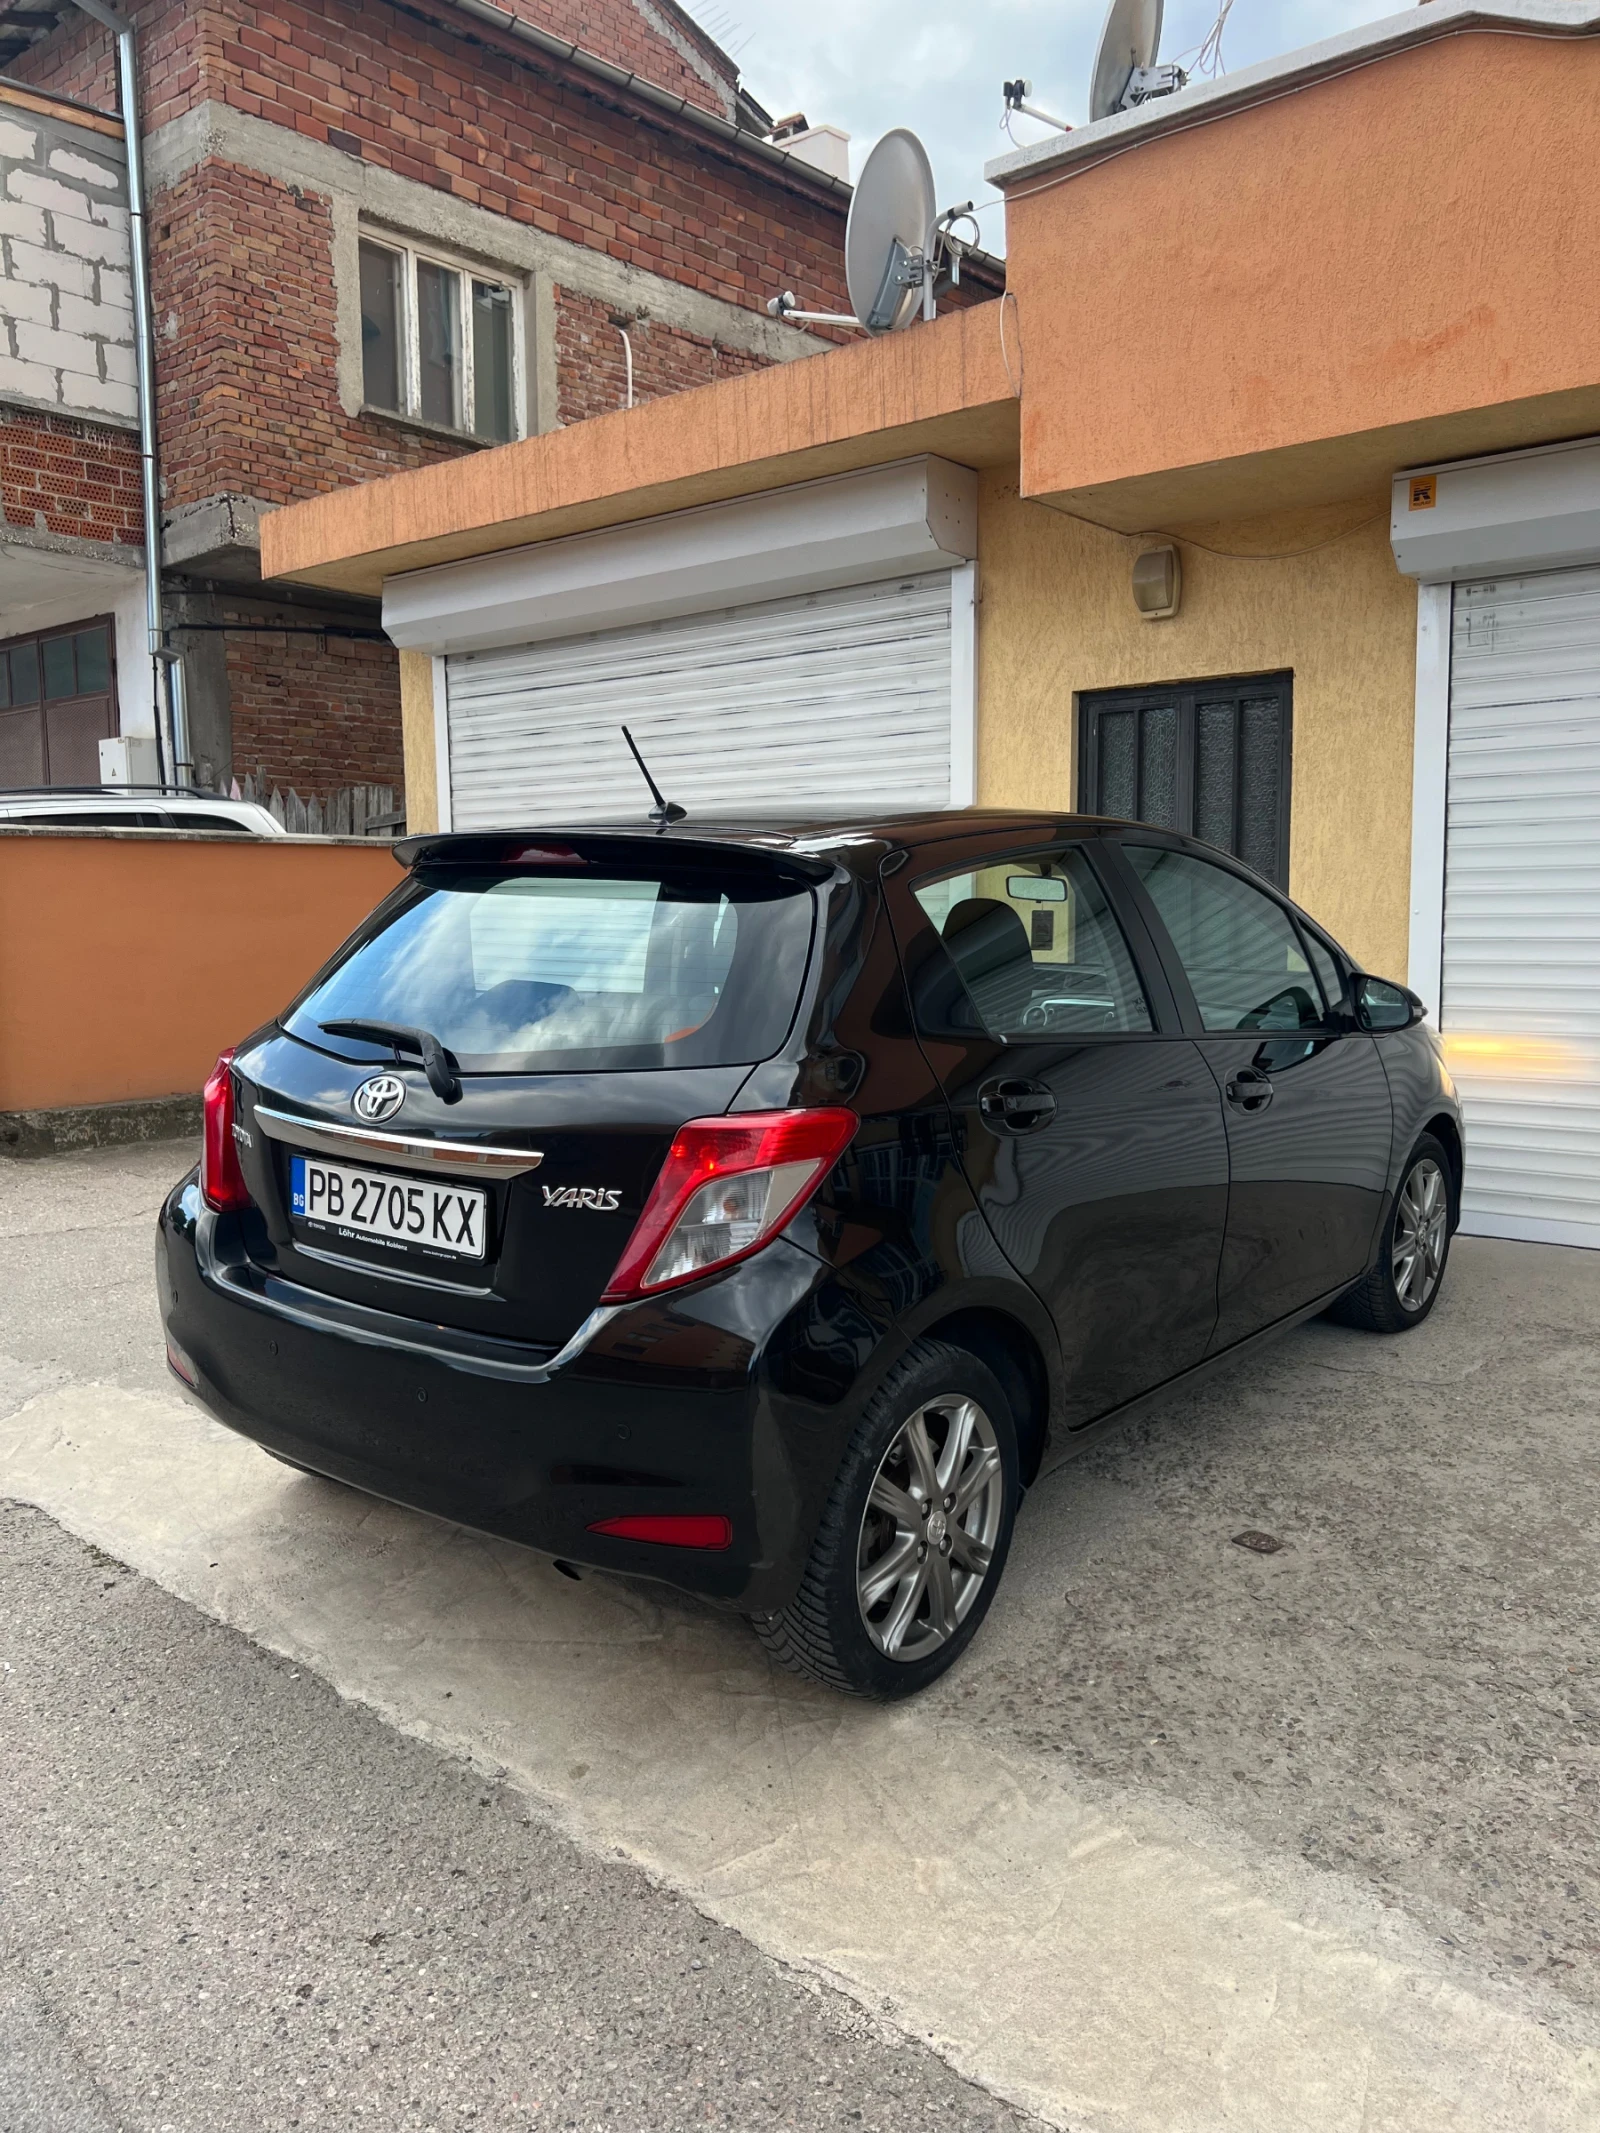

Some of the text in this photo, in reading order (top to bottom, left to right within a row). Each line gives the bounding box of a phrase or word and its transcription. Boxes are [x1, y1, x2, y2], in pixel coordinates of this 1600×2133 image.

[293, 1192, 305, 1207] BG
[309, 1167, 477, 1247] PB 2705 KX
[338, 1226, 408, 1251] Löhr Automobile Koblenz
